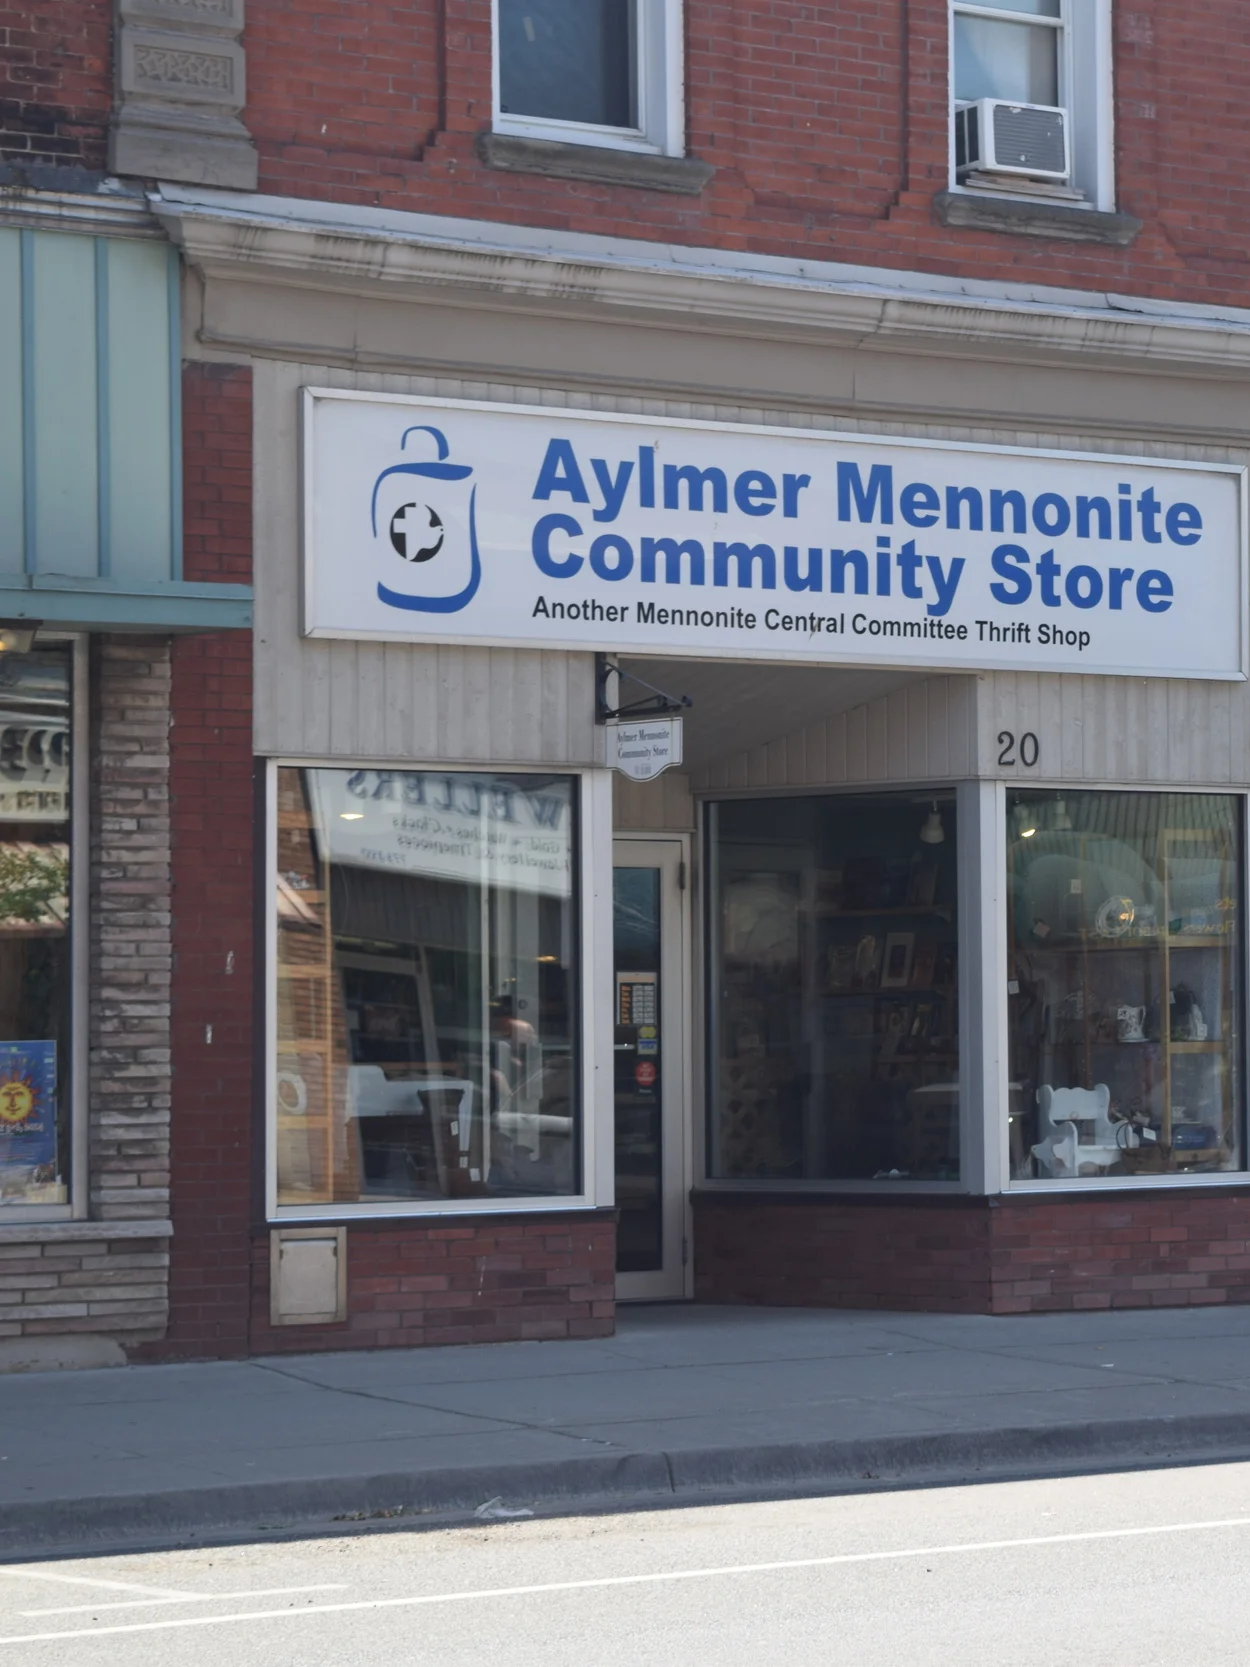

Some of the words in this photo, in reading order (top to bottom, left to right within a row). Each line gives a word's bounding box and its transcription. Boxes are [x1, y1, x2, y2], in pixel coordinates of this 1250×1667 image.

[532, 438, 811, 522] Aylmer
[837, 461, 1203, 546] Mennonite
[532, 513, 966, 617] Community
[989, 544, 1174, 613] Store
[532, 596, 629, 623] Another
[637, 602, 756, 629] Mennonite
[764, 608, 845, 634] Central
[852, 613, 968, 640] Committee
[975, 621, 1031, 644] Thrift
[1037, 624, 1091, 651] Shop
[998, 731, 1039, 767] 20
